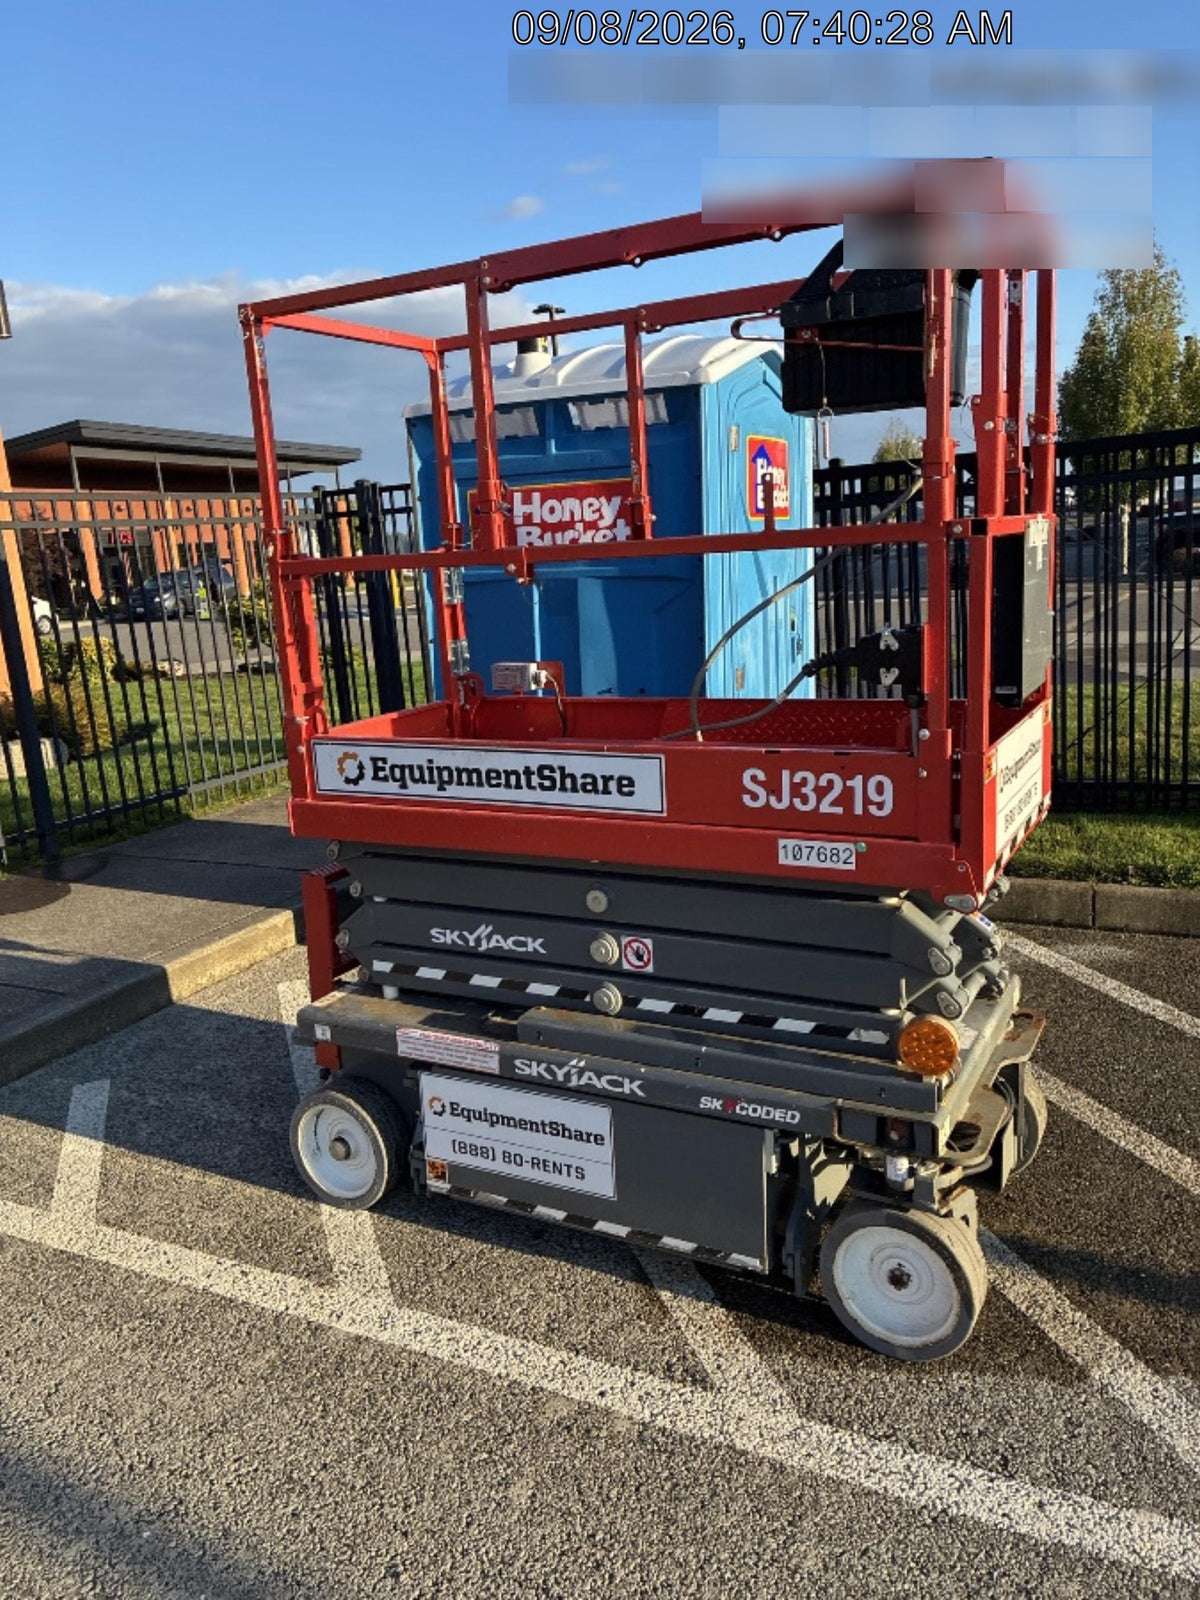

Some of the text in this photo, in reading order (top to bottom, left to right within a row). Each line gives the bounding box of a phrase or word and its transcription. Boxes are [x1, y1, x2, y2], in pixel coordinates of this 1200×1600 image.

[513, 492, 620, 528] Honey
[369, 756, 636, 797] EquipmentShare
[741, 767, 894, 817] SJ3219
[780, 844, 854, 865] 107682
[429, 923, 547, 955] SKYJACK
[513, 1057, 646, 1098] SKYJACK
[449, 1101, 606, 1146] EquipmentShare
